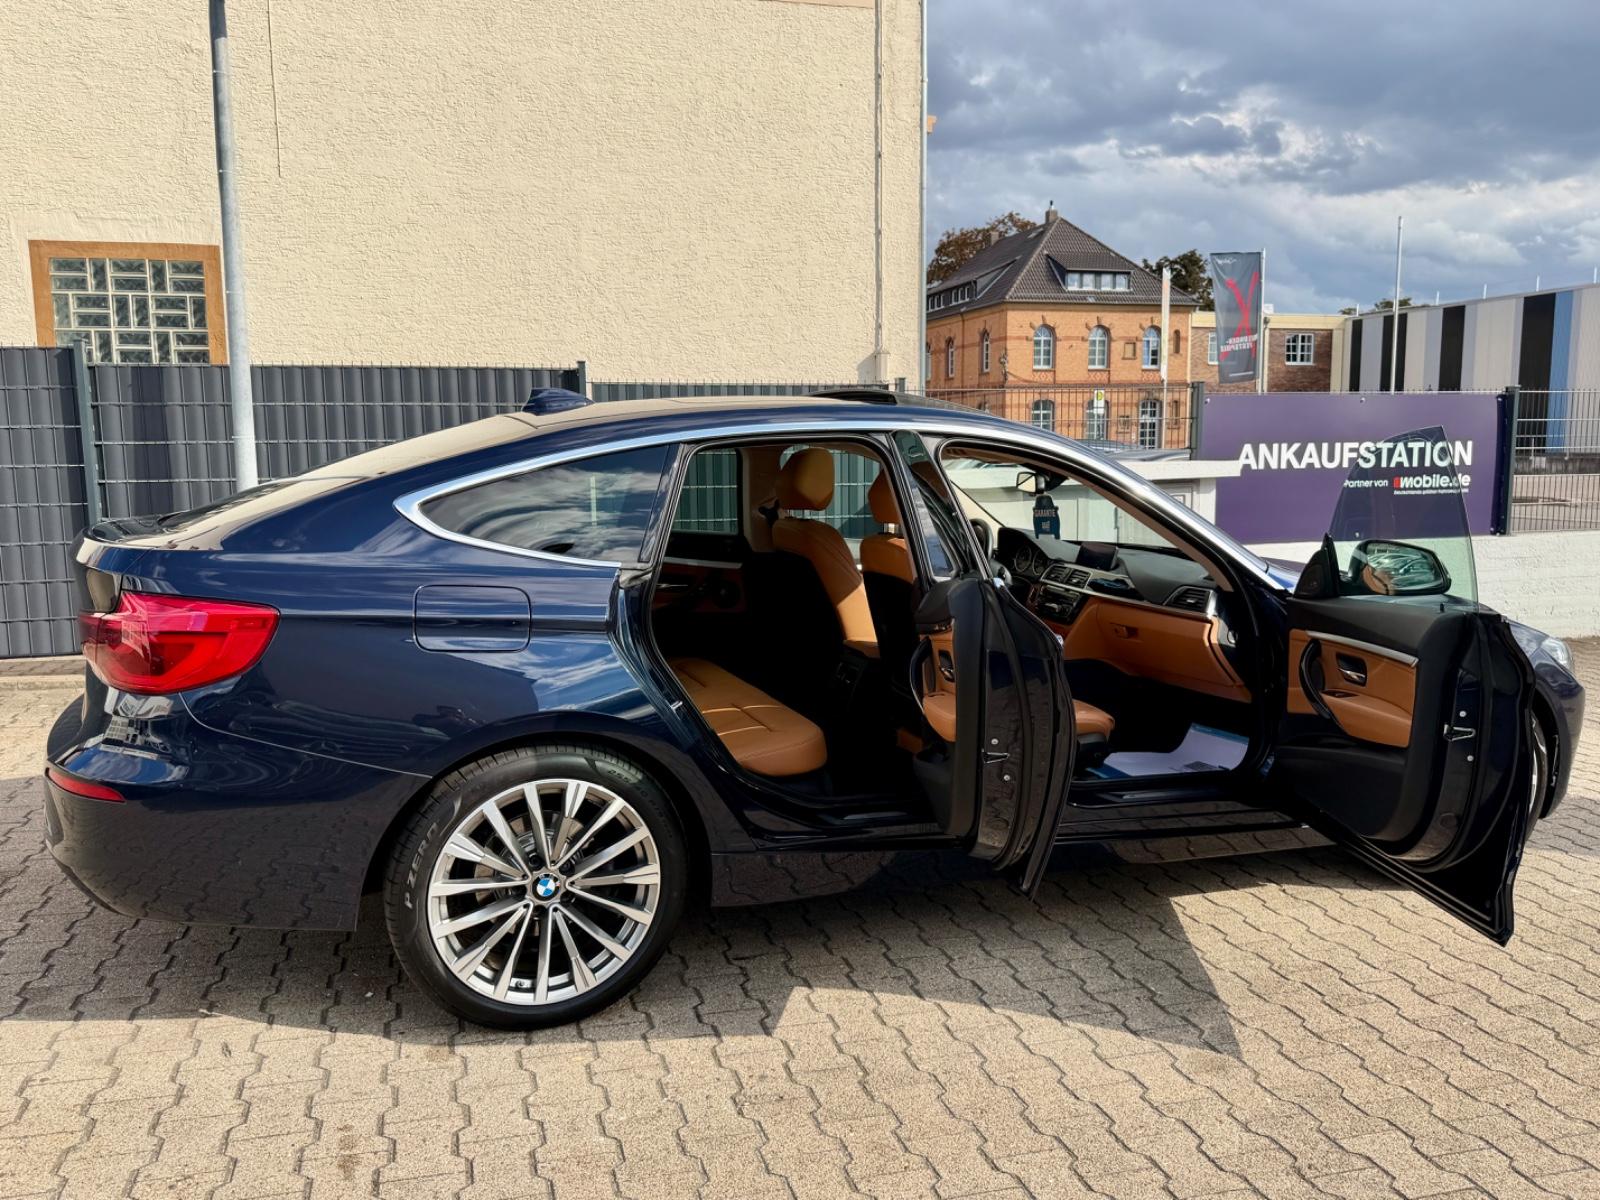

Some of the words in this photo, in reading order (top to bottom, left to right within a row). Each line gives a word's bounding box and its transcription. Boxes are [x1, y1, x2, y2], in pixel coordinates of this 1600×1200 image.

[1239, 440, 1473, 470] ANKAUFSTATION
[1344, 479, 1373, 489] Partner
[1374, 479, 1388, 487] von
